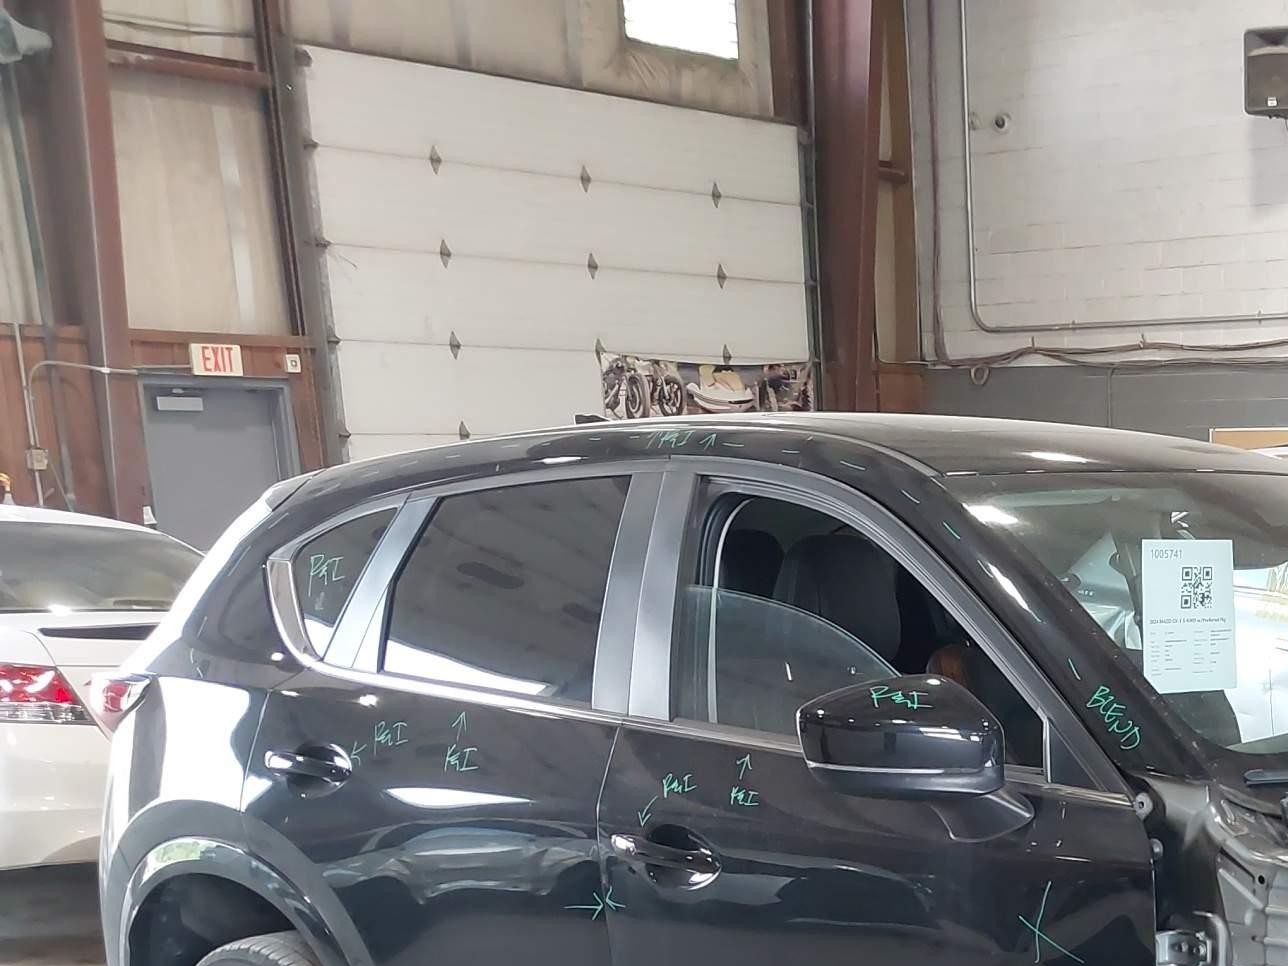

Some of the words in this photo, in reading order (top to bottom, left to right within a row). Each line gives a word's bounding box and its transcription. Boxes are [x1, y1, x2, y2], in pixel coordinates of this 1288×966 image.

[201, 345, 233, 372] EXIT
[1150, 549, 1183, 559] 1005741
[1086, 686, 1140, 750] BLEND
